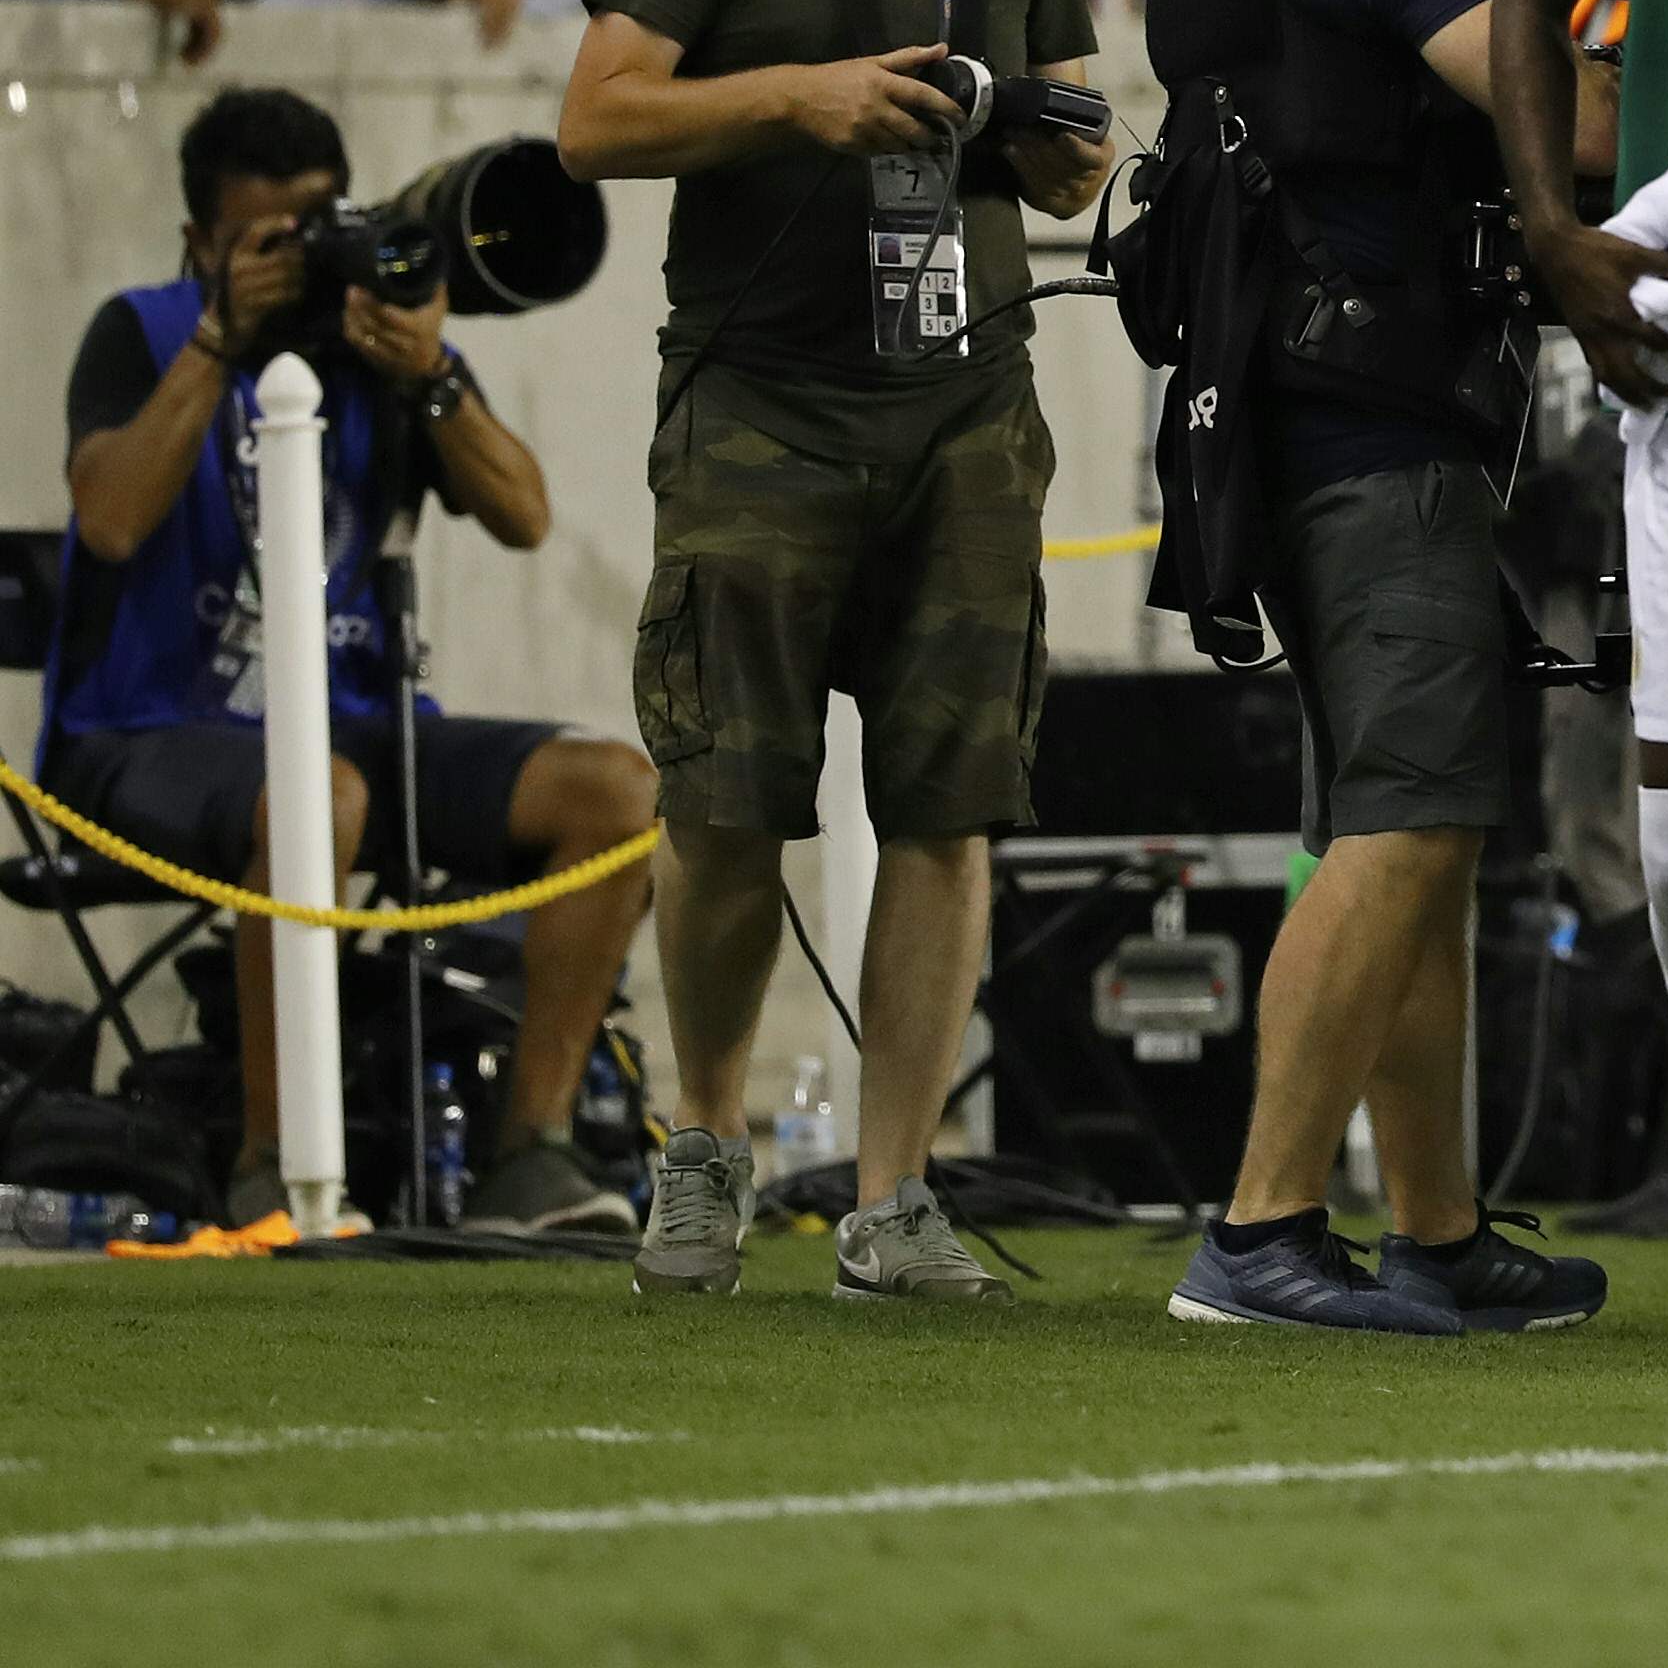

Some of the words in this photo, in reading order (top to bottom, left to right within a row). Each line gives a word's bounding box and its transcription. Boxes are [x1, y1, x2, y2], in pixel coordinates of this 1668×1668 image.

[905, 170, 919, 193] 7
[924, 276, 931, 288] 1
[943, 277, 950, 290] 2
[925, 297, 933, 310] 3
[926, 319, 933, 332] 5
[944, 319, 951, 332] 6
